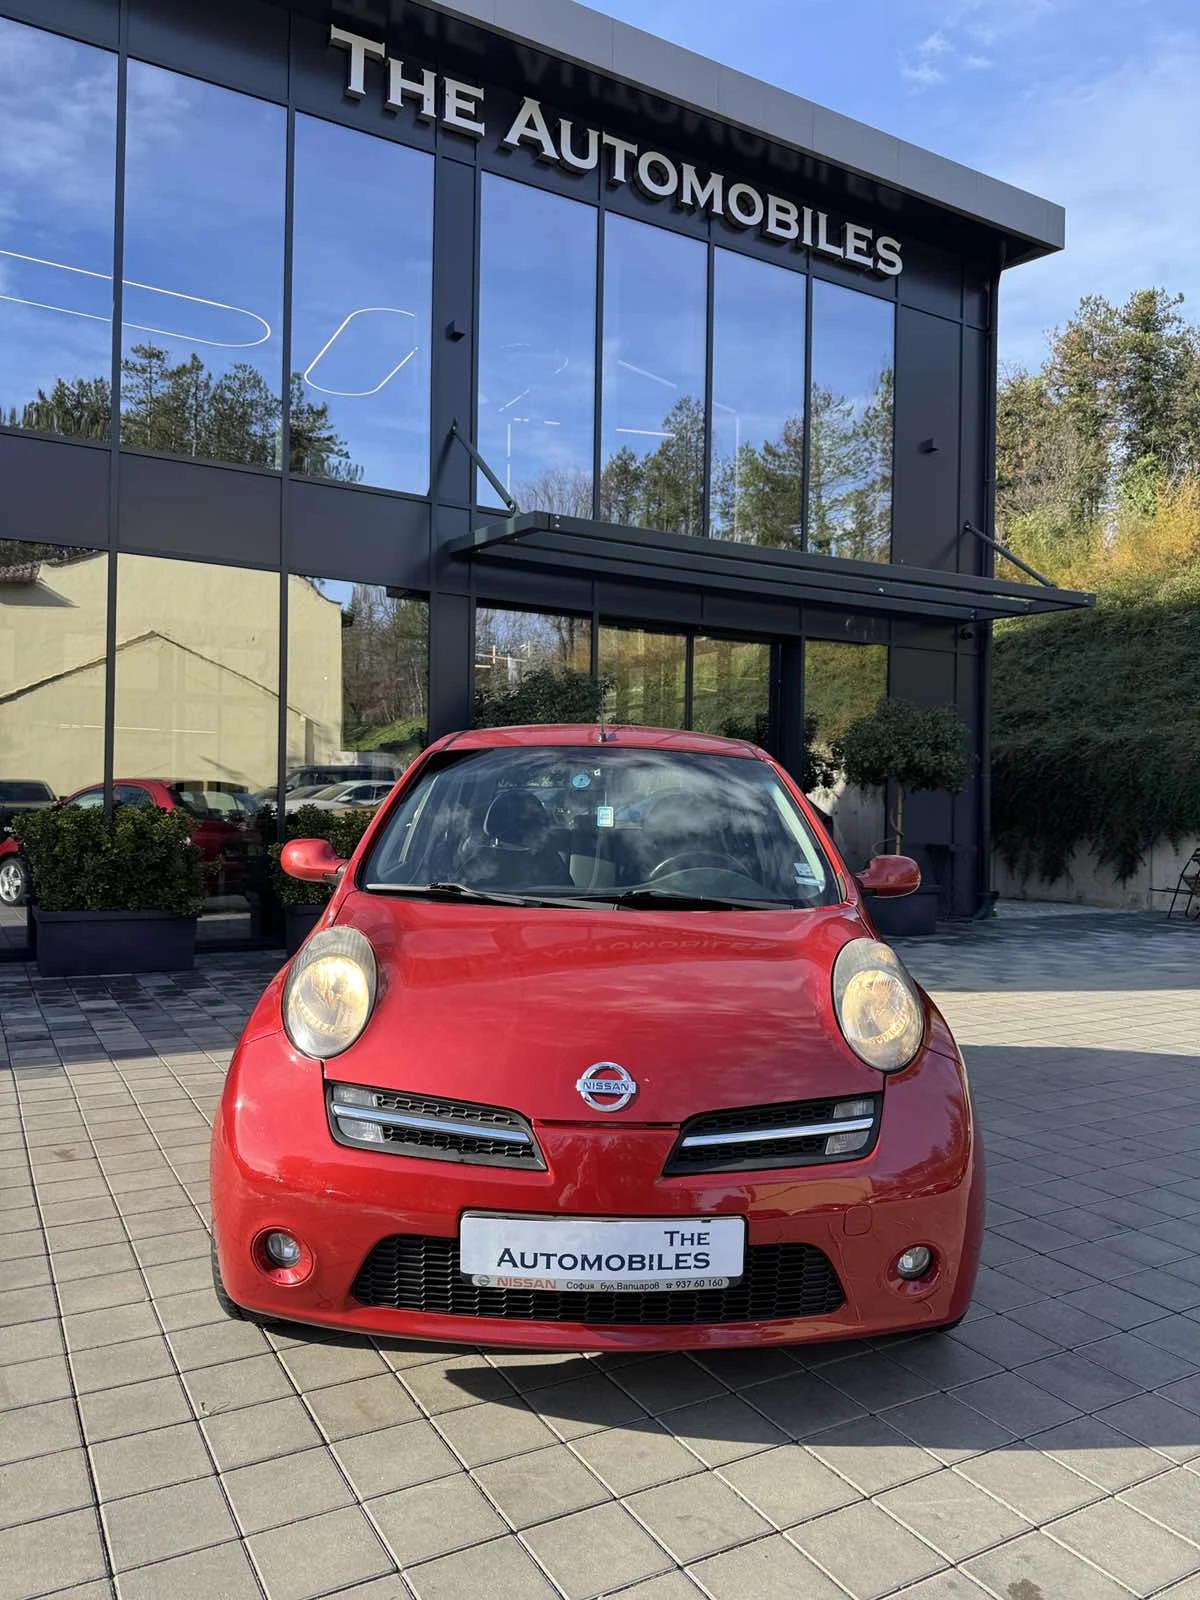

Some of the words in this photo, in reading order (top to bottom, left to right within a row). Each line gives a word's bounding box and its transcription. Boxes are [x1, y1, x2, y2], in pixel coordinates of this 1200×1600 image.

[330, 23, 486, 138] THE
[503, 95, 903, 277] AUTOMOBILES
[582, 1081, 630, 1091] NISSAN
[663, 1230, 711, 1247] THE
[496, 1247, 711, 1272] AUTOMOBILES
[495, 1277, 557, 1289] NISSAN
[566, 1280, 595, 1290] София
[675, 1280, 692, 1289] 937
[694, 1279, 705, 1288] 60
[708, 1278, 723, 1287] 160
